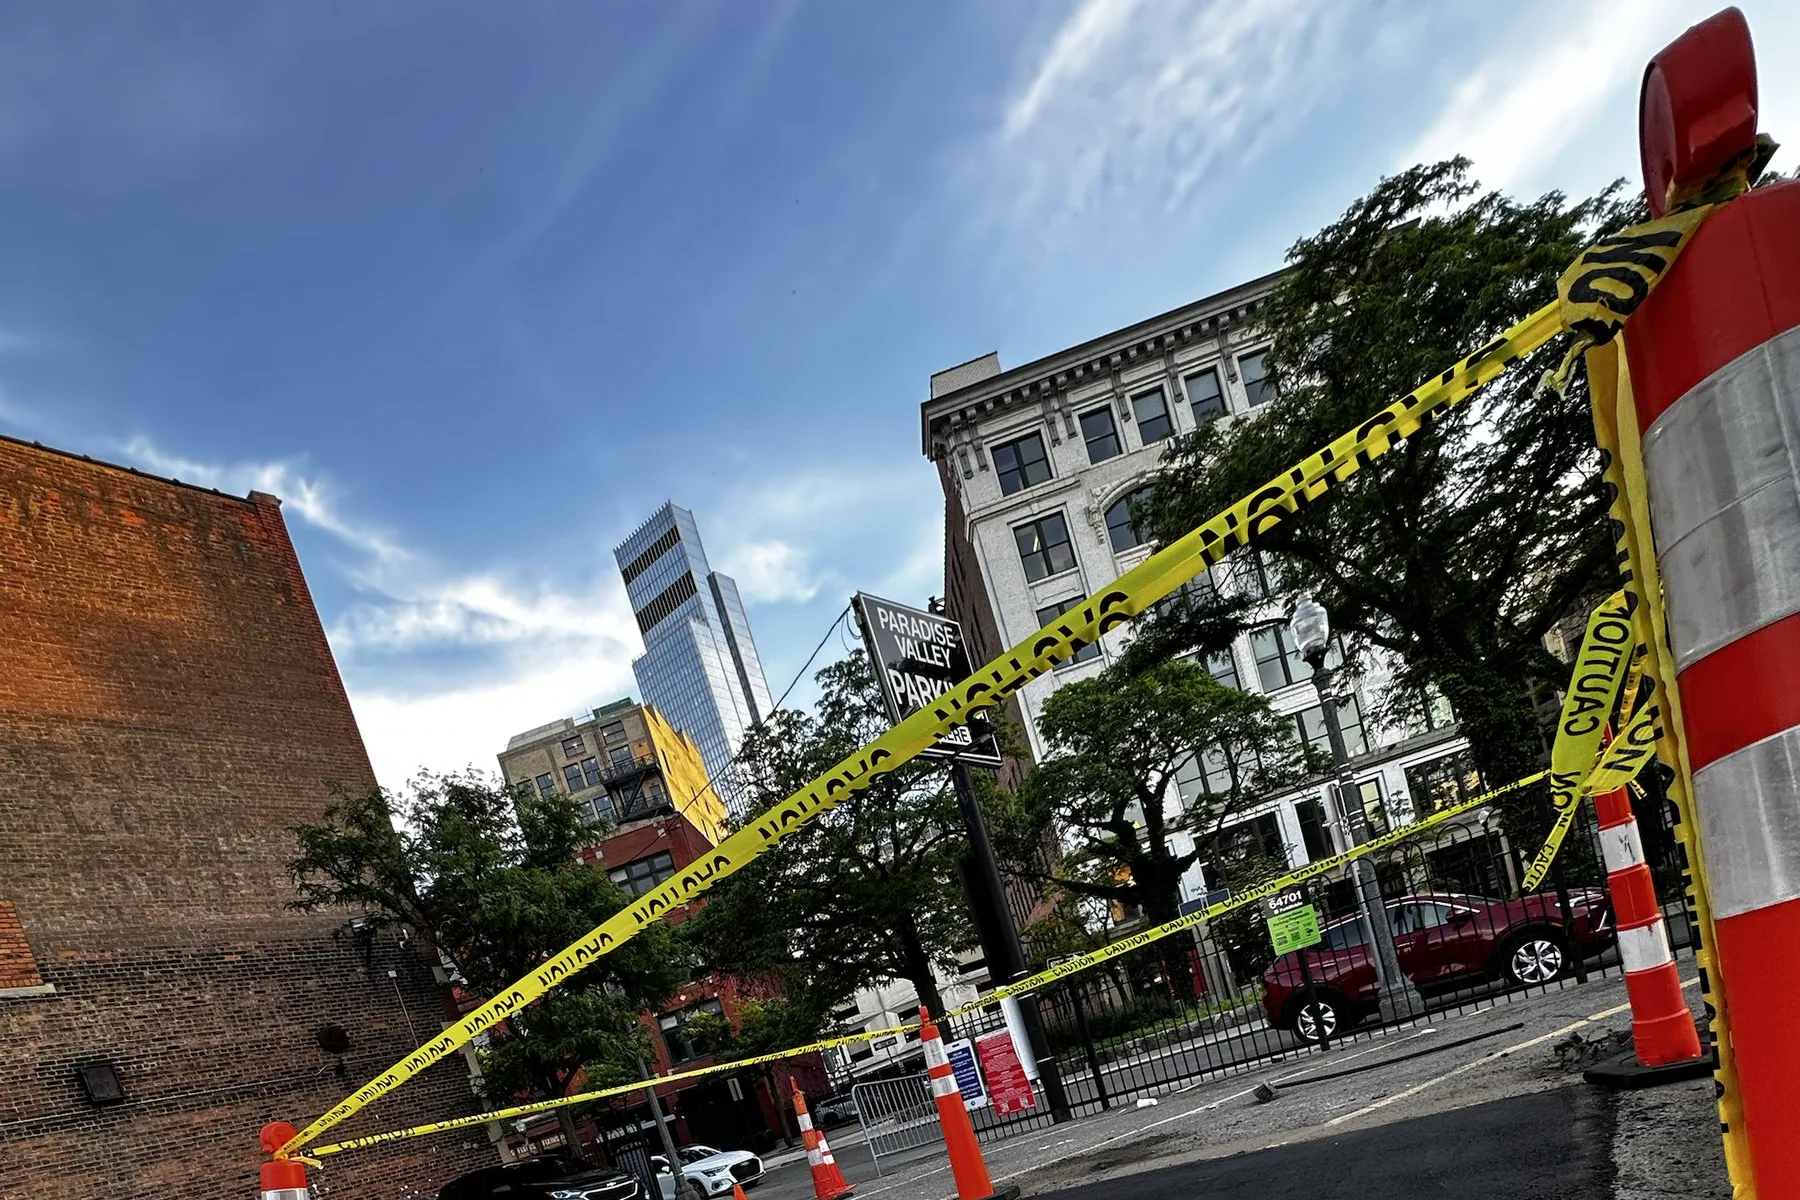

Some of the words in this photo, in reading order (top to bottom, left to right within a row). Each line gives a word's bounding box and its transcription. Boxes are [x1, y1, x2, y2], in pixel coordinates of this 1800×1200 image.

[877, 607, 957, 648] PARADISE
[894, 635, 951, 669] VALLEY
[887, 669, 954, 708] PARK
[1269, 890, 1302, 909] 64701
[1053, 956, 1095, 977] CAUTION
[1104, 933, 1150, 956] CAUTION
[1161, 908, 1210, 932] CAUTION
[1222, 882, 1276, 907] CAUTION
